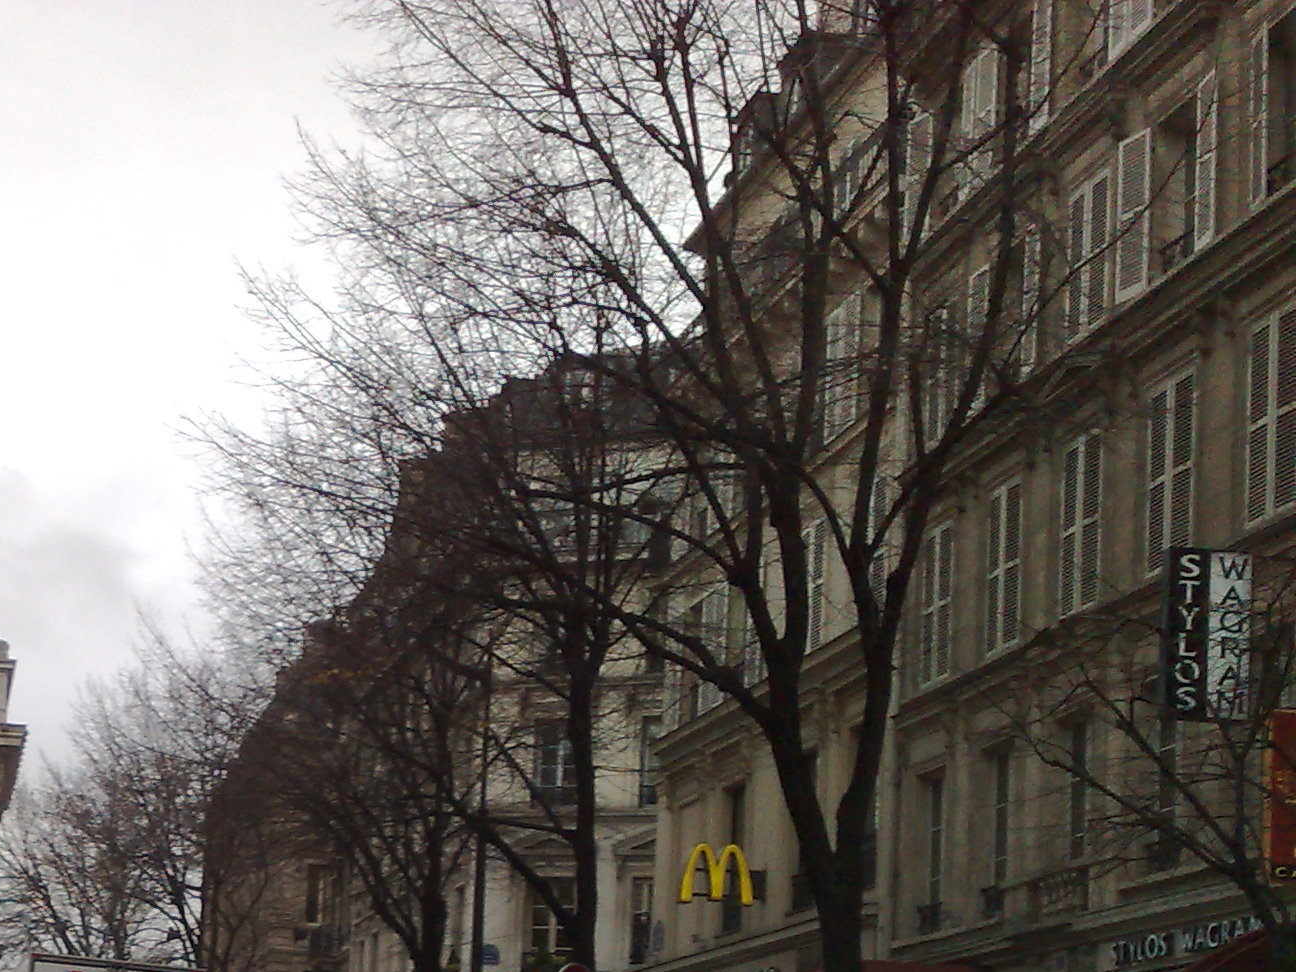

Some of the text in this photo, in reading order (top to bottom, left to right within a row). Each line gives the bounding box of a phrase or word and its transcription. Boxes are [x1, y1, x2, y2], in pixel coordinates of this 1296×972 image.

[1174, 553, 1201, 712] STYLOS
[1217, 555, 1249, 715] WAGRAM
[1111, 933, 1167, 965] STYLOS
